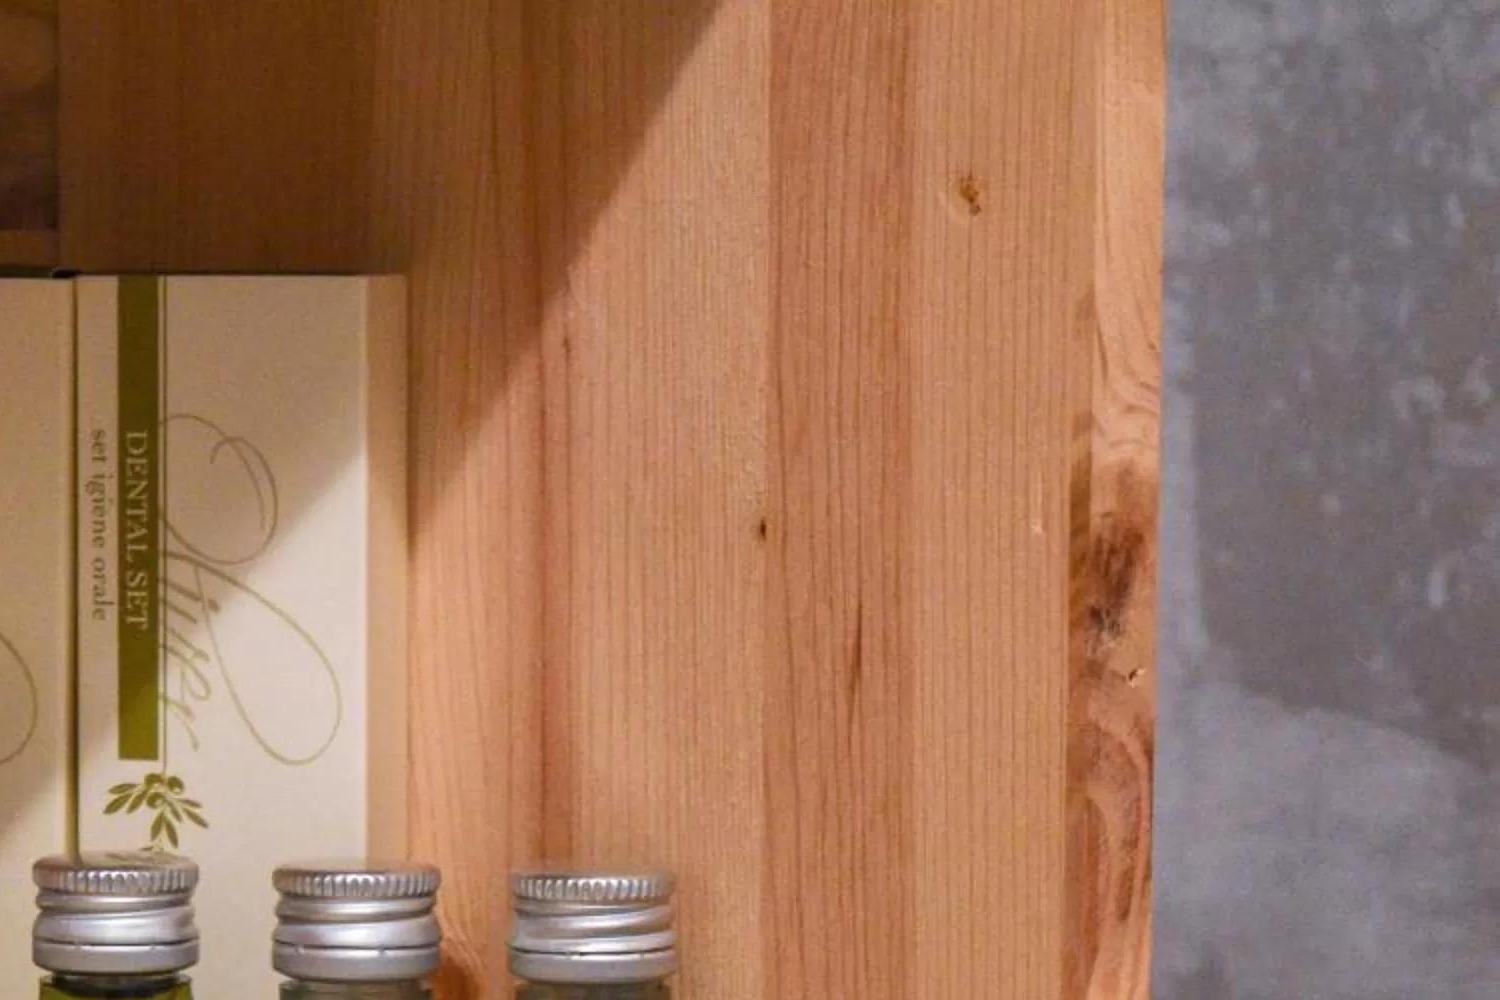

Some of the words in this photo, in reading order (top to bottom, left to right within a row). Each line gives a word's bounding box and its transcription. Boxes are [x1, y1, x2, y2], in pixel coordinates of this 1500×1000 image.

[91, 428, 108, 463] set
[84, 473, 115, 549] igiene
[125, 431, 150, 563] DENTAL
[91, 557, 116, 621] orale
[125, 570, 150, 631] SET
